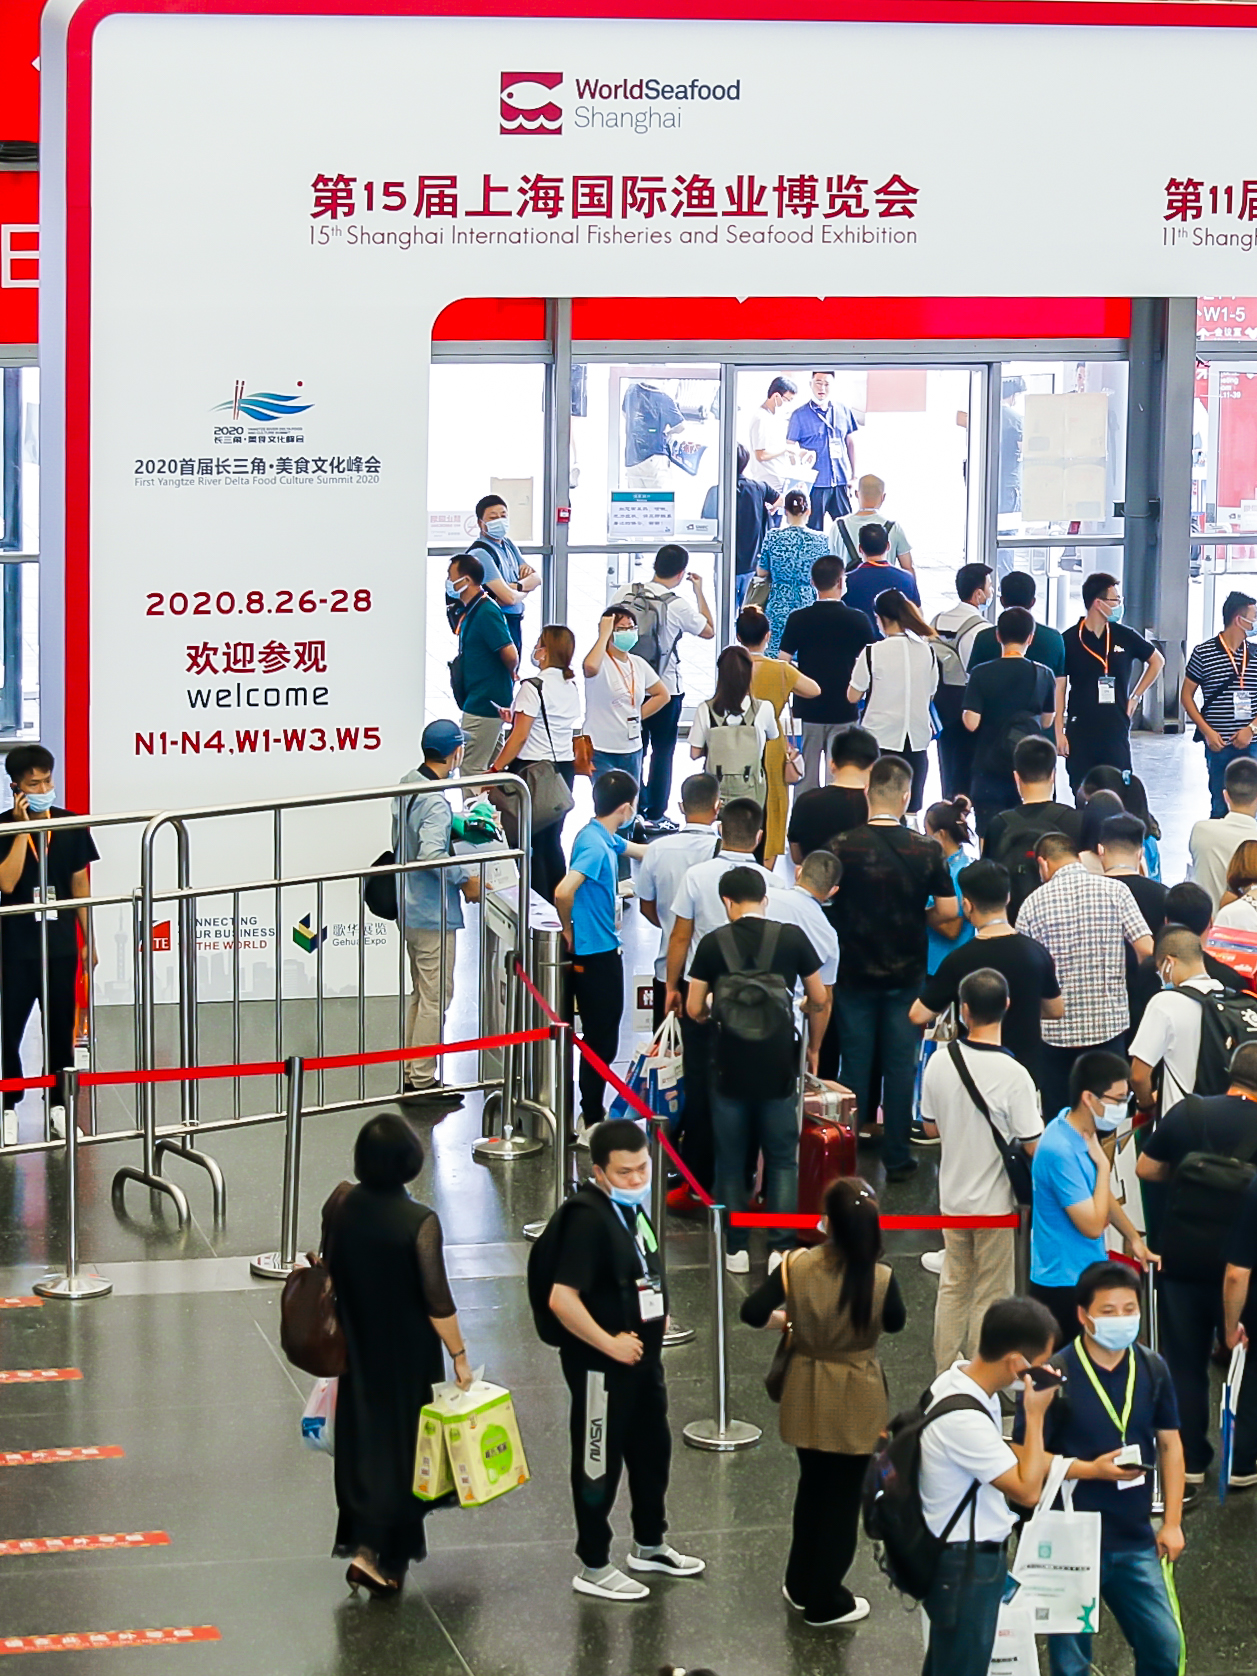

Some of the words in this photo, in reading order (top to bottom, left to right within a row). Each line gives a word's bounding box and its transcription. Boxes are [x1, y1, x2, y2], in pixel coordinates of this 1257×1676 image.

[575, 78, 741, 101] WorldSeafood
[574, 105, 682, 135] Shanghai
[310, 172, 921, 221] 第15届上海国际渔业博览会
[309, 225, 342, 245] 15th
[347, 224, 444, 250] Shanghai
[452, 224, 580, 245] International
[587, 224, 672, 244] Fisheries
[679, 225, 719, 244] and
[725, 224, 814, 244] Seafood
[821, 224, 917, 244] Exhibition
[1162, 227, 1188, 246] 11th
[1203, 306, 1246, 322] W1-5
[213, 426, 244, 435] 2020
[134, 455, 382, 476] 2020首届长三角·美食文化峰会
[134, 478, 155, 487] First
[157, 477, 195, 488] Yangtze
[197, 477, 222, 486] River
[224, 477, 250, 486] Delta
[252, 476, 277, 485] Food
[279, 476, 314, 485] Culture
[316, 475, 354, 485] Summit
[355, 475, 380, 484] 2020
[145, 588, 372, 616] 2020.8.26-28
[185, 640, 328, 676] 欢迎参观
[187, 683, 329, 709] welcome
[135, 726, 382, 756] N1-N4,W1-W3,W5
[196, 917, 257, 926] NNECTNG
[215, 928, 275, 938] BUINESS
[364, 937, 387, 946] Expo
